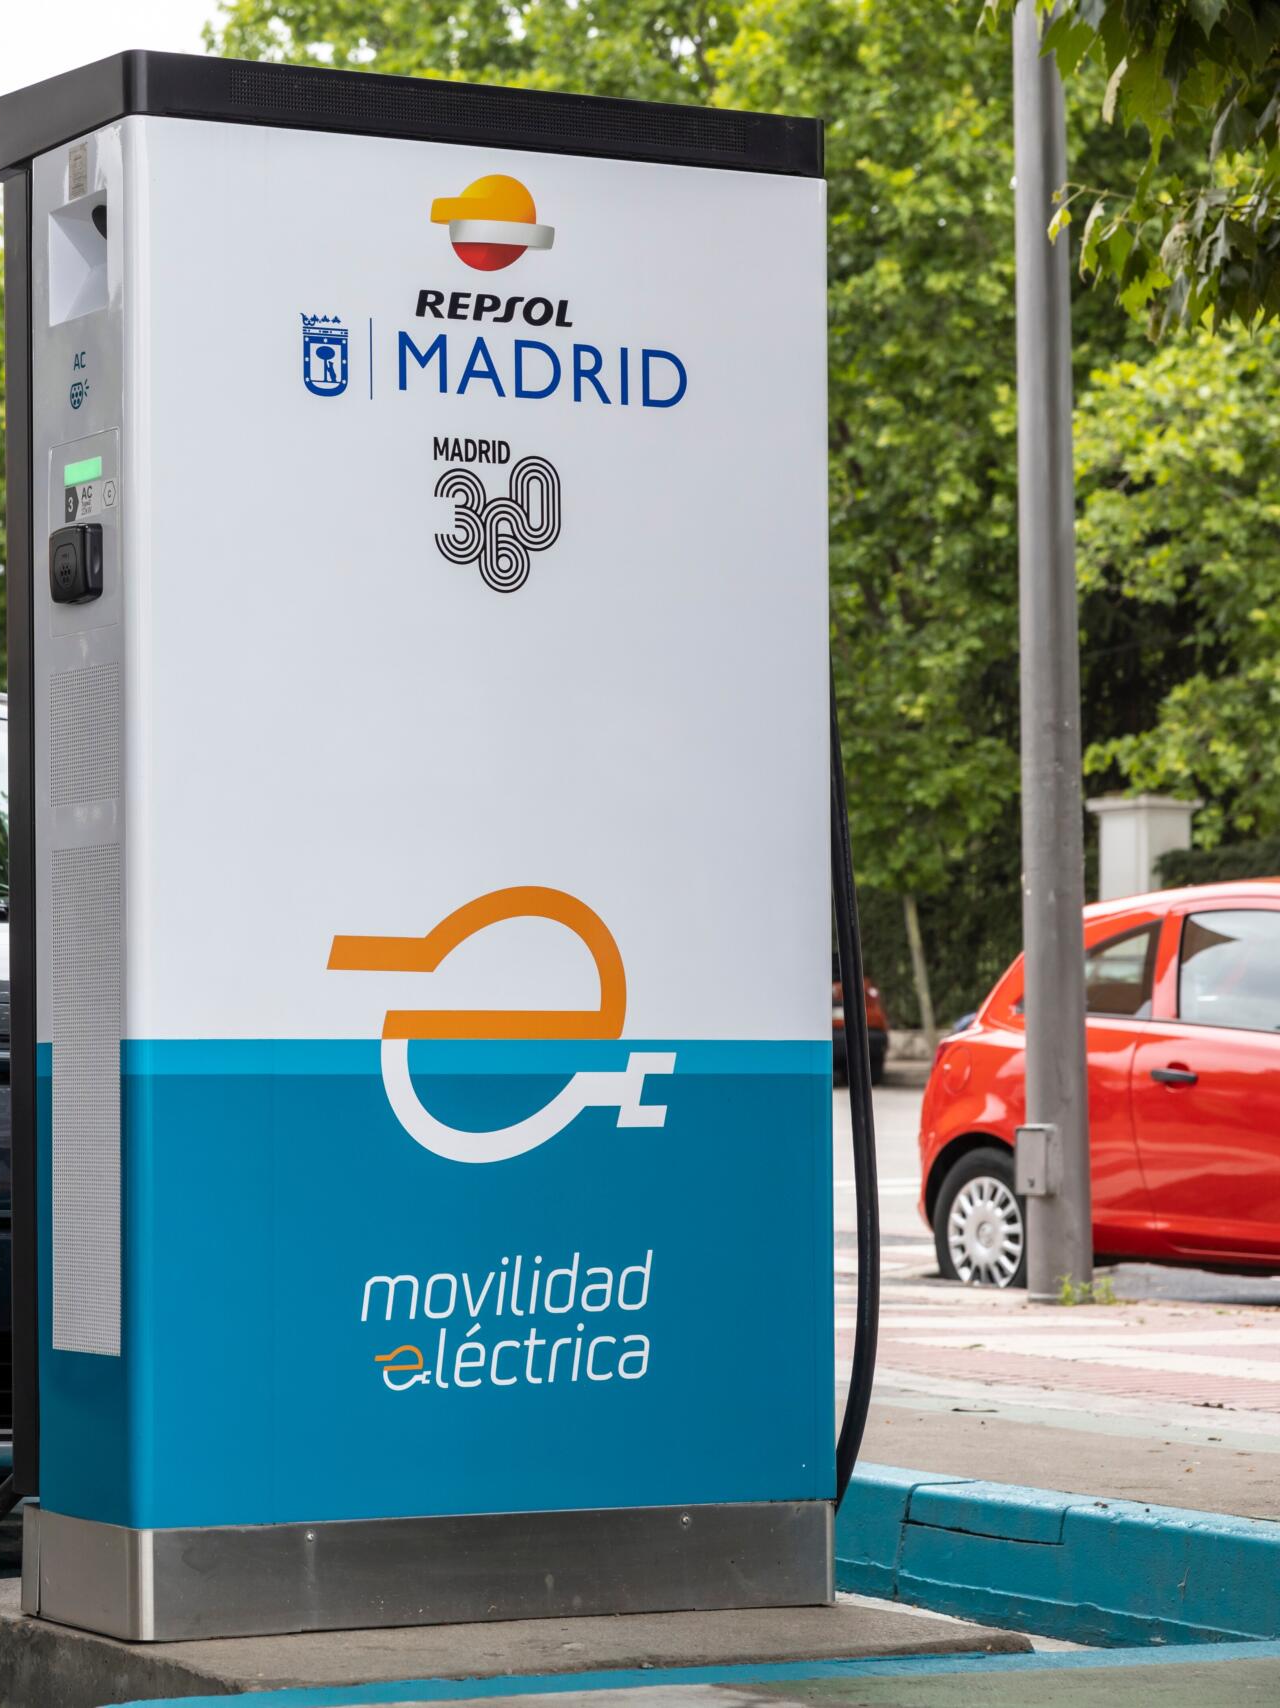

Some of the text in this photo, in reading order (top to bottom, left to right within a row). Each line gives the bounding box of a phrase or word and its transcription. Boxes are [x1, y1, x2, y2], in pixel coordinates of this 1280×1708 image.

[416, 290, 573, 327] REPSOL
[73, 351, 86, 371] AC
[398, 331, 688, 409] MADRID
[433, 436, 511, 465] MADRID
[67, 496, 74, 513] 3
[81, 485, 93, 500] AC
[434, 455, 562, 594] 360
[361, 1249, 654, 1322] movilidad
[374, 1322, 651, 1392] eléctrica
